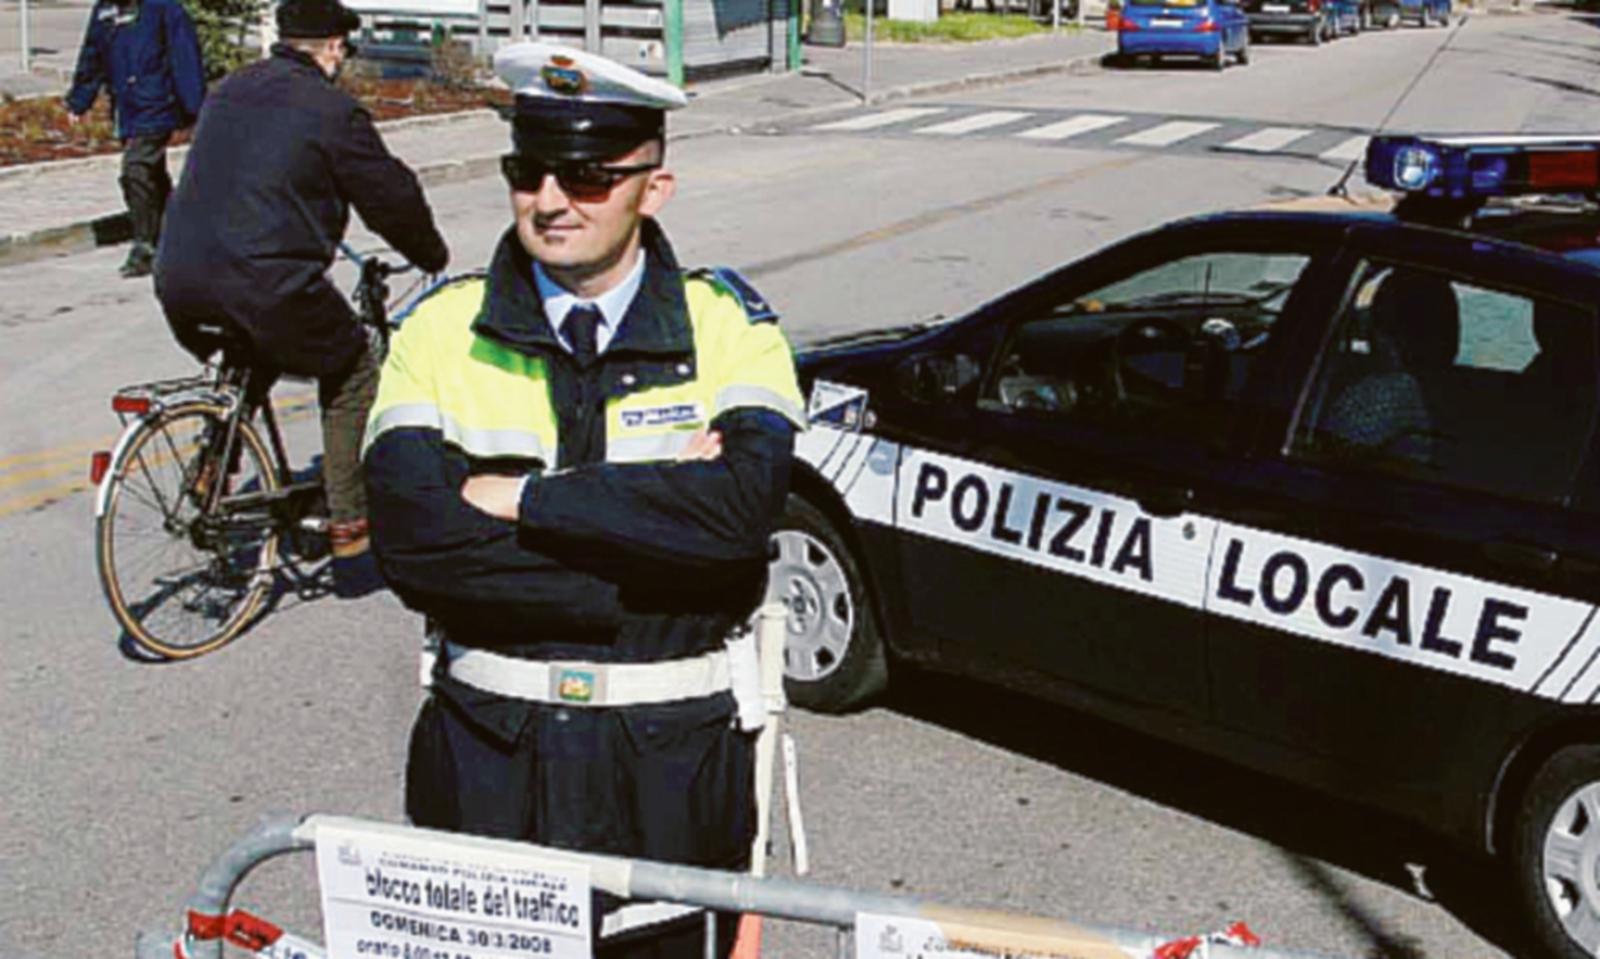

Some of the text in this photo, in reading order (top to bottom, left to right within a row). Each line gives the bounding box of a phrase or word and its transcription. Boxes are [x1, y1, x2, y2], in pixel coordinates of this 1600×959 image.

[911, 463, 1529, 670] POLIZIA LOCALE
[365, 866, 579, 928] blocco totale del traffico
[370, 910, 462, 942] DOMENICA
